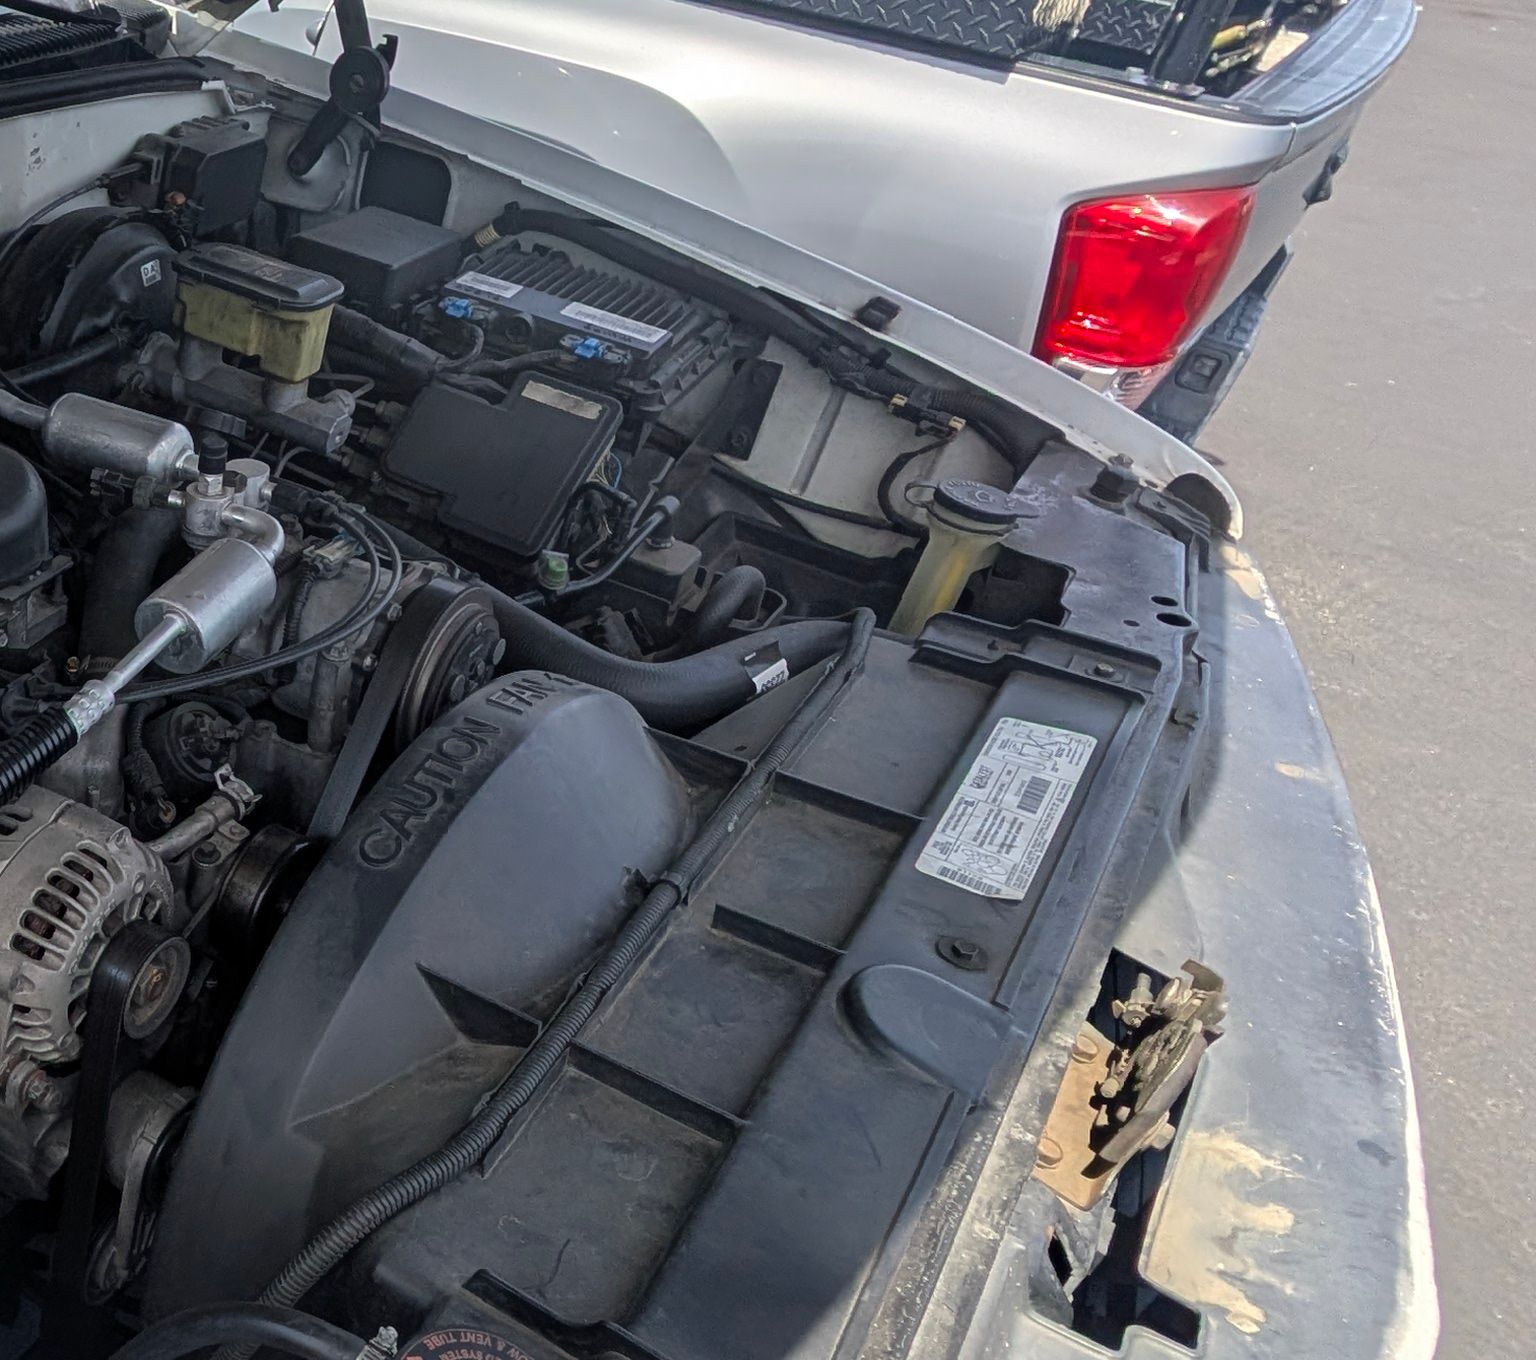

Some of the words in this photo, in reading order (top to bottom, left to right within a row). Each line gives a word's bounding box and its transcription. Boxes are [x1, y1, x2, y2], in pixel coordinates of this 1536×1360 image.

[358, 716, 502, 868] CAUTION
[423, 1332, 457, 1350] TUBE
[460, 1332, 492, 1347] VENT
